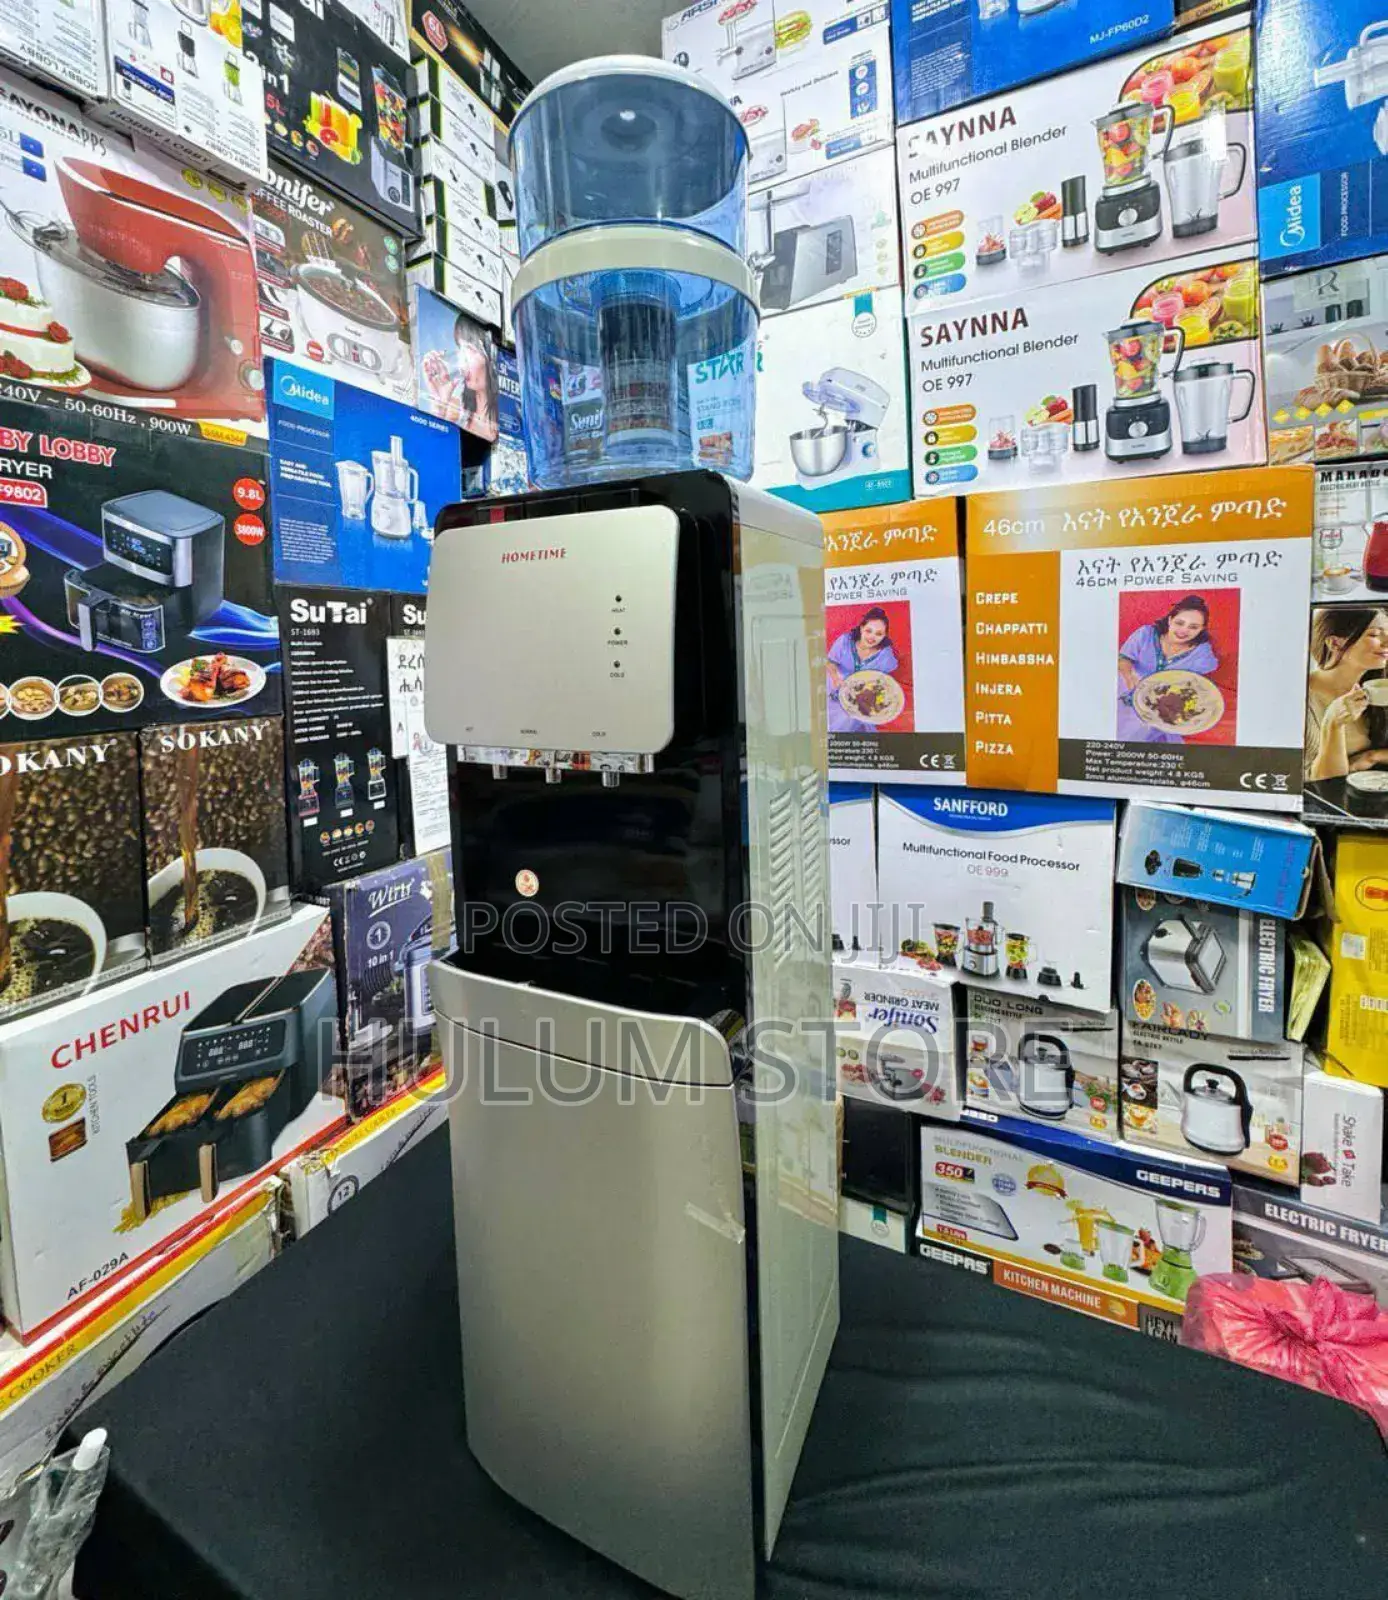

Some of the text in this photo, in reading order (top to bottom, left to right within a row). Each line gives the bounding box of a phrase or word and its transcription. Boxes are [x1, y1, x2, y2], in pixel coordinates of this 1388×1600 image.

[908, 105, 1018, 159] AYNNA
[908, 125, 1068, 185] Multifunctional Blender
[909, 177, 961, 206] OE 997
[1279, 185, 1305, 247] Midea
[920, 306, 1030, 348] SAYNNA
[920, 333, 1079, 373] Multifunctional Blender
[279, 374, 330, 407] Midea
[922, 373, 973, 394] OE 997
[64, 398, 138, 426] 50-60Hz
[149, 416, 193, 436] 900W
[39, 434, 117, 468] LOBBY
[982, 518, 1046, 538] 46cm
[500, 547, 567, 565] HOMETIME
[289, 597, 368, 625] SuTai
[159, 723, 267, 755] SOKANY
[933, 796, 1009, 818] SANFFORD
[902, 842, 1081, 872] Multifunctional Food Processor
[1258, 919, 1276, 1014] ELECTRIC FRYER
[864, 990, 910, 1007] GRINDER
[911, 999, 940, 1011] MEAT
[50, 989, 191, 1070] CHENRUI
[867, 1006, 939, 1035] Sonifer
[1135, 1169, 1221, 1199] GEEPERS
[1341, 1161, 1357, 1188] Take
[1264, 1202, 1388, 1252] ELECTRIC FRYER
[919, 1244, 988, 1275] GEEPAS
[66, 1251, 130, 1301] AF-029A
[1002, 1269, 1102, 1310] KITCHEN MACHINE
